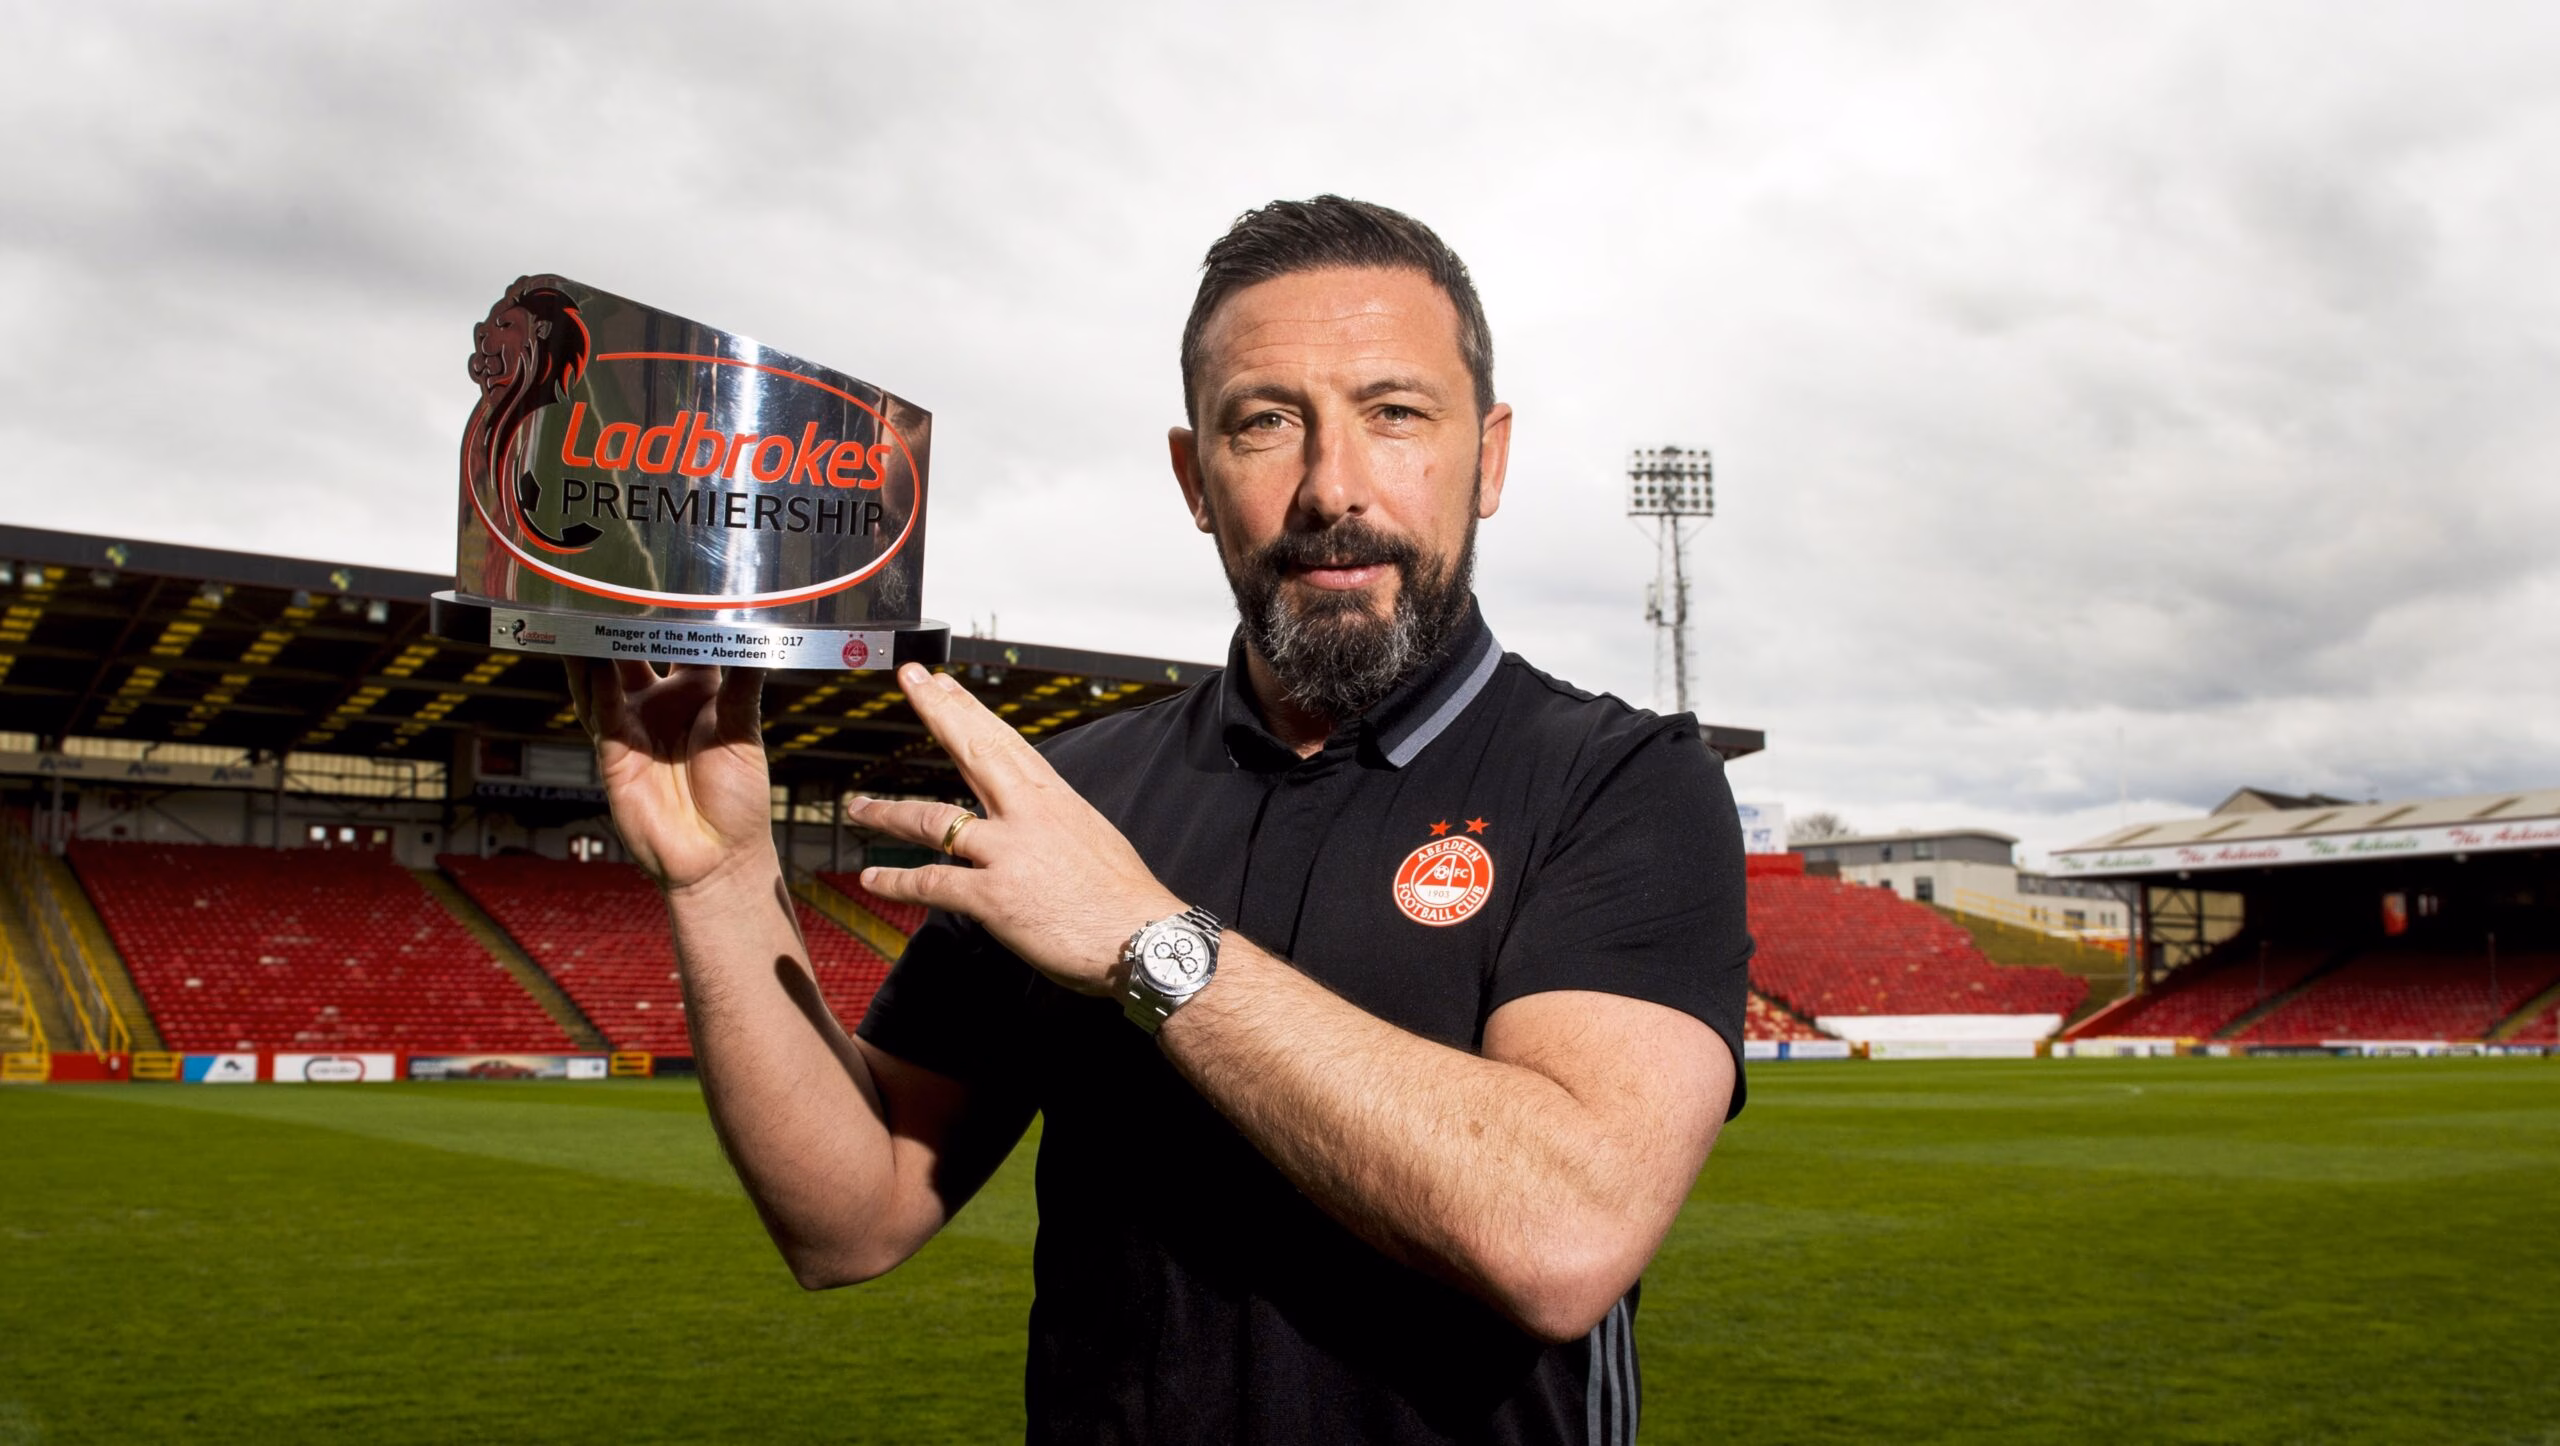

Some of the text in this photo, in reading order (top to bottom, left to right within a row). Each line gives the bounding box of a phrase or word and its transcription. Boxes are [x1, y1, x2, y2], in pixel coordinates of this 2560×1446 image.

[560, 401, 892, 490] Ladbrokes
[562, 478, 884, 537] PREMIERSHIP
[595, 625, 645, 640] Manager
[649, 629, 661, 639] of
[665, 629, 683, 641] the
[687, 631, 724, 643] Month
[735, 634, 770, 645] March
[612, 641, 646, 653] Derek
[650, 644, 700, 656] McInnes
[711, 647, 767, 659] Aberdeen
[1418, 840, 1482, 863] ABERDEEN
[1398, 882, 1486, 921] FOOTBALL CLUB
[1427, 888, 1450, 899] 1903
